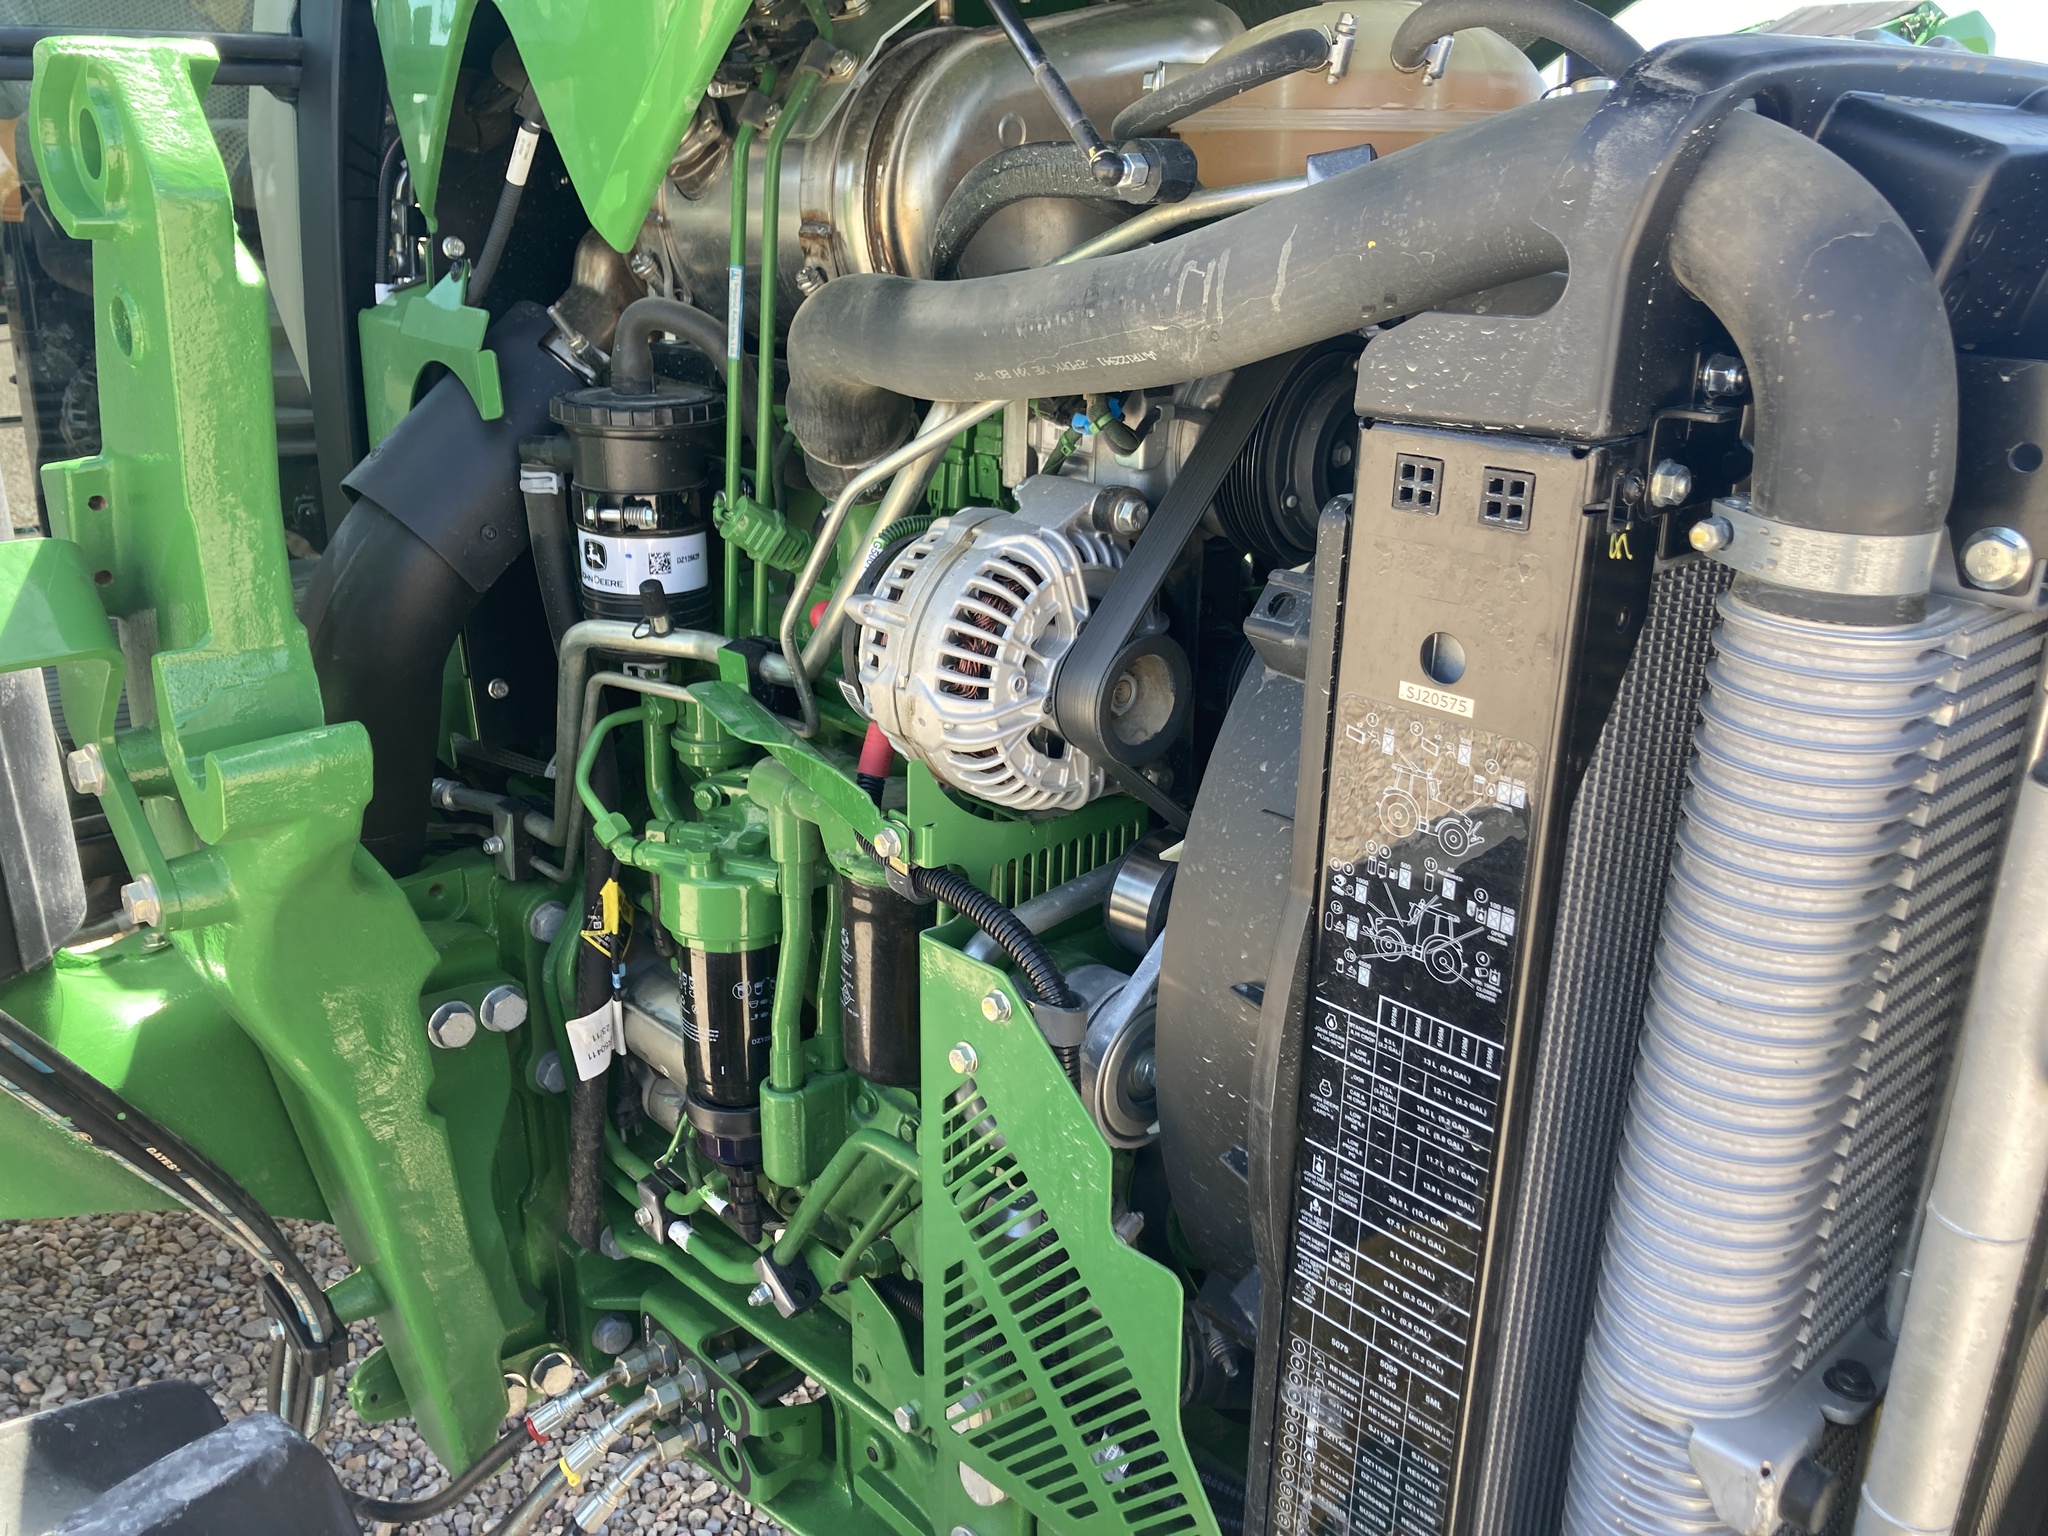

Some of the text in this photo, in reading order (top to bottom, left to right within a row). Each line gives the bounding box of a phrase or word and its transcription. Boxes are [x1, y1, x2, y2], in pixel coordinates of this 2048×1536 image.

[594, 574, 624, 588] DEERE
[1405, 686, 1468, 714] SJ20575
[1383, 727, 1395, 736] 500
[1459, 737, 1472, 747] 500
[1399, 861, 1411, 870] 500
[1355, 876, 1368, 886] 1000
[1489, 901, 1514, 916] 100 500
[1346, 913, 1360, 924] 1500
[1486, 933, 1508, 947] CENTER
[1490, 929, 1505, 940] OPEN
[1349, 1051, 1371, 1066] PROFILE
[1354, 1047, 1367, 1058] LOW
[1439, 1064, 1452, 1077] (3.4
[1452, 1070, 1471, 1085] GAL)
[1432, 1085, 1446, 1098] 12.1
[1454, 1095, 1468, 1109] (3.2
[1468, 1101, 1487, 1118] GAL)
[1437, 1113, 1451, 1127] (5.2
[1451, 1120, 1469, 1135] GAL)
[1446, 1137, 1464, 1154] GAL)
[1343, 1167, 1357, 1180] OPEN
[1425, 1154, 1438, 1166] 11.7
[1447, 1164, 1460, 1177] (3.1
[1459, 1170, 1479, 1187] GAL)
[1339, 1172, 1359, 1187] CENTER
[1337, 1194, 1357, 1210] CENTER
[1457, 1198, 1475, 1214] GAL)
[1388, 1194, 1403, 1208] 39.5
[1411, 1206, 1429, 1223] (10.4
[1429, 1216, 1448, 1233] GAL)
[1385, 1216, 1400, 1230] 47.5
[1408, 1228, 1426, 1245] (12.5
[1426, 1238, 1445, 1255] GAL)
[1331, 1255, 1350, 1271] MFWD
[1402, 1257, 1416, 1271] (1.3
[1416, 1264, 1435, 1282] GAL)
[1383, 1278, 1394, 1291] 0.8
[1402, 1289, 1416, 1304] (0.2
[1416, 1297, 1434, 1314] GAL)
[1380, 1305, 1390, 1316] 3.1
[1399, 1316, 1412, 1330] (0.8
[1412, 1323, 1431, 1342] GAL)
[1330, 1336, 1348, 1354] 5075
[1389, 1337, 1402, 1351] 12.1
[1412, 1350, 1425, 1365] (3.2
[1425, 1358, 1444, 1376] GAL)
[1379, 1358, 1398, 1376] 5095
[1377, 1373, 1396, 1391] 5130
[1425, 1393, 1442, 1411] 5ML
